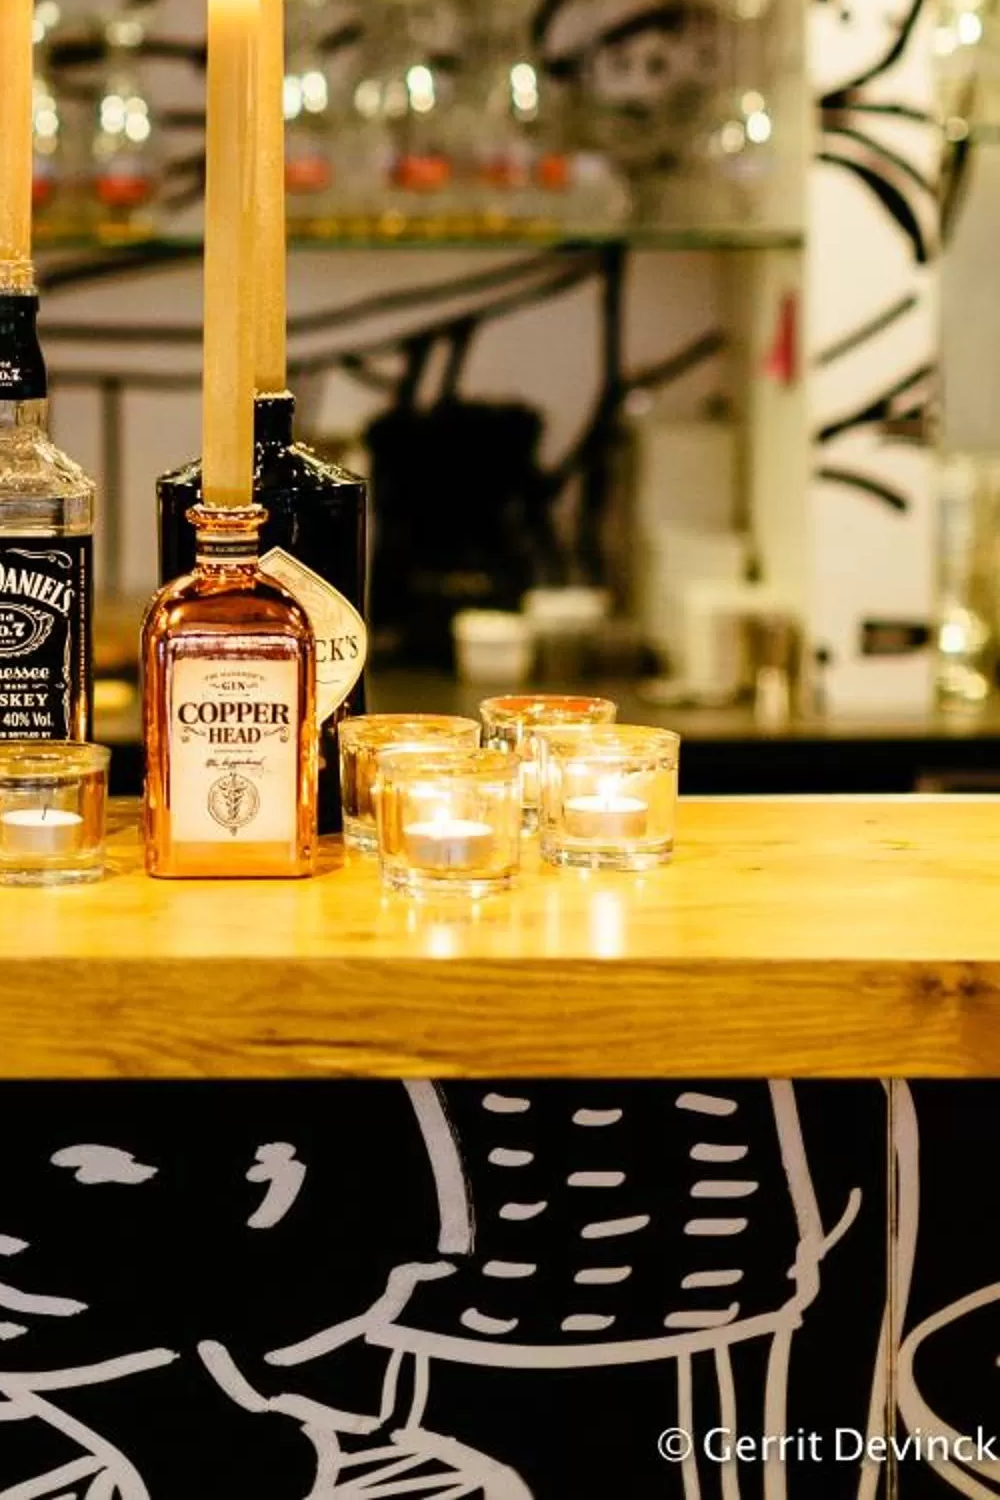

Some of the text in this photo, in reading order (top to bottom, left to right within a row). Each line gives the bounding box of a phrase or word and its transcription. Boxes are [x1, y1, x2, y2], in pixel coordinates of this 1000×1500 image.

[315, 635, 359, 662] CK'S
[221, 681, 245, 691] GIN
[2, 712, 30, 727] 40%
[32, 712, 54, 727] Vol.
[178, 701, 290, 725] COPPER
[208, 727, 261, 744] HEAD
